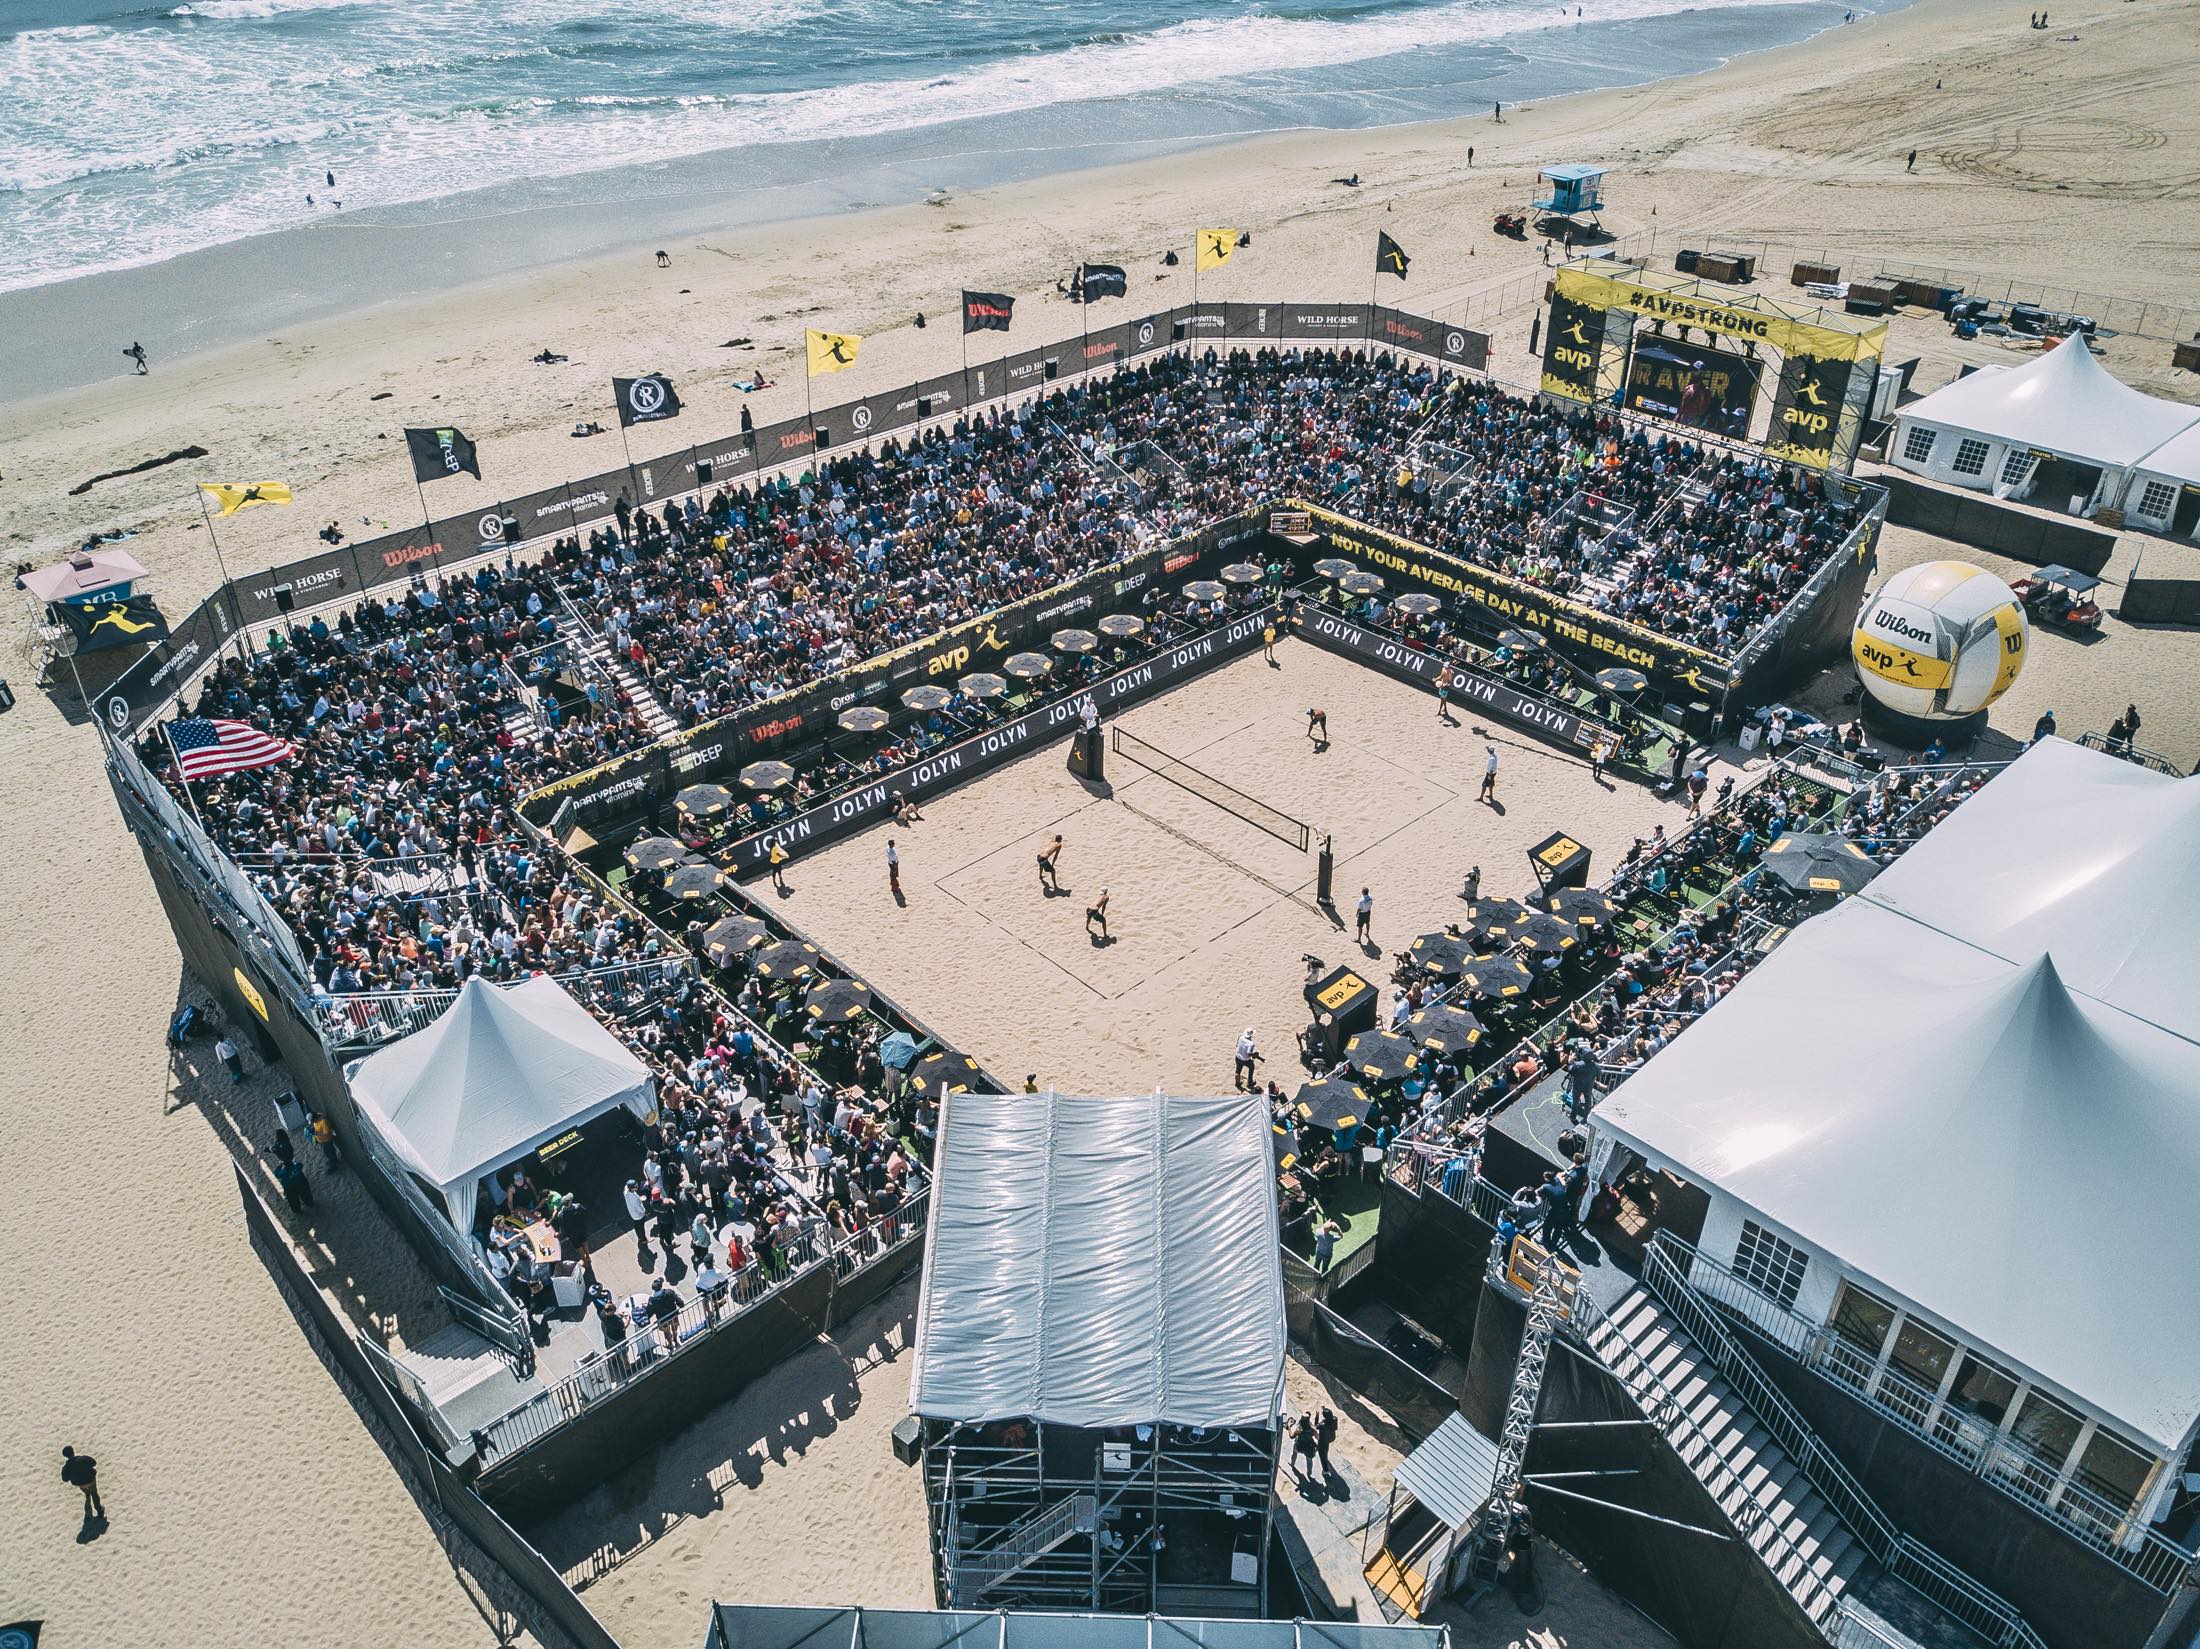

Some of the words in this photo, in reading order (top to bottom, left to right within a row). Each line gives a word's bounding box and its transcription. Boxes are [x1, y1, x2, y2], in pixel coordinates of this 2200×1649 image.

[1297, 315, 1324, 324] WILD
[1326, 315, 1359, 324] HORSE
[1629, 291, 1768, 337] #AVPSTRONG
[1083, 342, 1117, 358] Wilson
[1554, 345, 1593, 371] avp
[1010, 364, 1032, 378] WILD
[1783, 406, 1829, 432] avp
[780, 430, 816, 449] Wilso
[715, 448, 750, 464] HORSE
[536, 493, 598, 517] SMARTYPANTS
[382, 543, 444, 567] Wilson
[295, 568, 342, 589] HORSE
[1124, 573, 1146, 591] DEEP
[1036, 597, 1084, 622] SMARTYPANTS
[1331, 533, 1363, 554] NOT
[1365, 546, 1407, 573] YOUR
[1409, 563, 1485, 604] AVERAGE
[1488, 592, 1525, 617] DAY
[1526, 608, 1550, 628] AT
[1554, 619, 1588, 645] THE
[1591, 633, 1656, 669] BEACH
[1227, 615, 1265, 643] JOLYN
[1315, 617, 1362, 646] JOLYN
[1875, 609, 1932, 644] Wilson
[1172, 639, 1212, 669] JOLYN
[2005, 632, 2021, 654] W
[150, 643, 192, 686] SMARTYPANTS
[929, 646, 969, 676] avp
[1375, 642, 1425, 672] JOLYN
[1862, 644, 1893, 670] avp
[1110, 666, 1152, 697] JOLYN
[1453, 674, 1496, 701] OLYN
[1512, 699, 1568, 732] JOLYN
[980, 723, 1027, 756] JOLYN
[693, 743, 723, 767] DEEP
[911, 753, 962, 787] JOLYN
[605, 788, 635, 804] vitamins
[833, 785, 886, 823] JOLYN
[753, 819, 811, 858] JOLYN
[1547, 851, 1563, 862] avp
[1326, 990, 1345, 1005] avp
[539, 1142, 558, 1156] BEER
[558, 1131, 578, 1146] DECK
